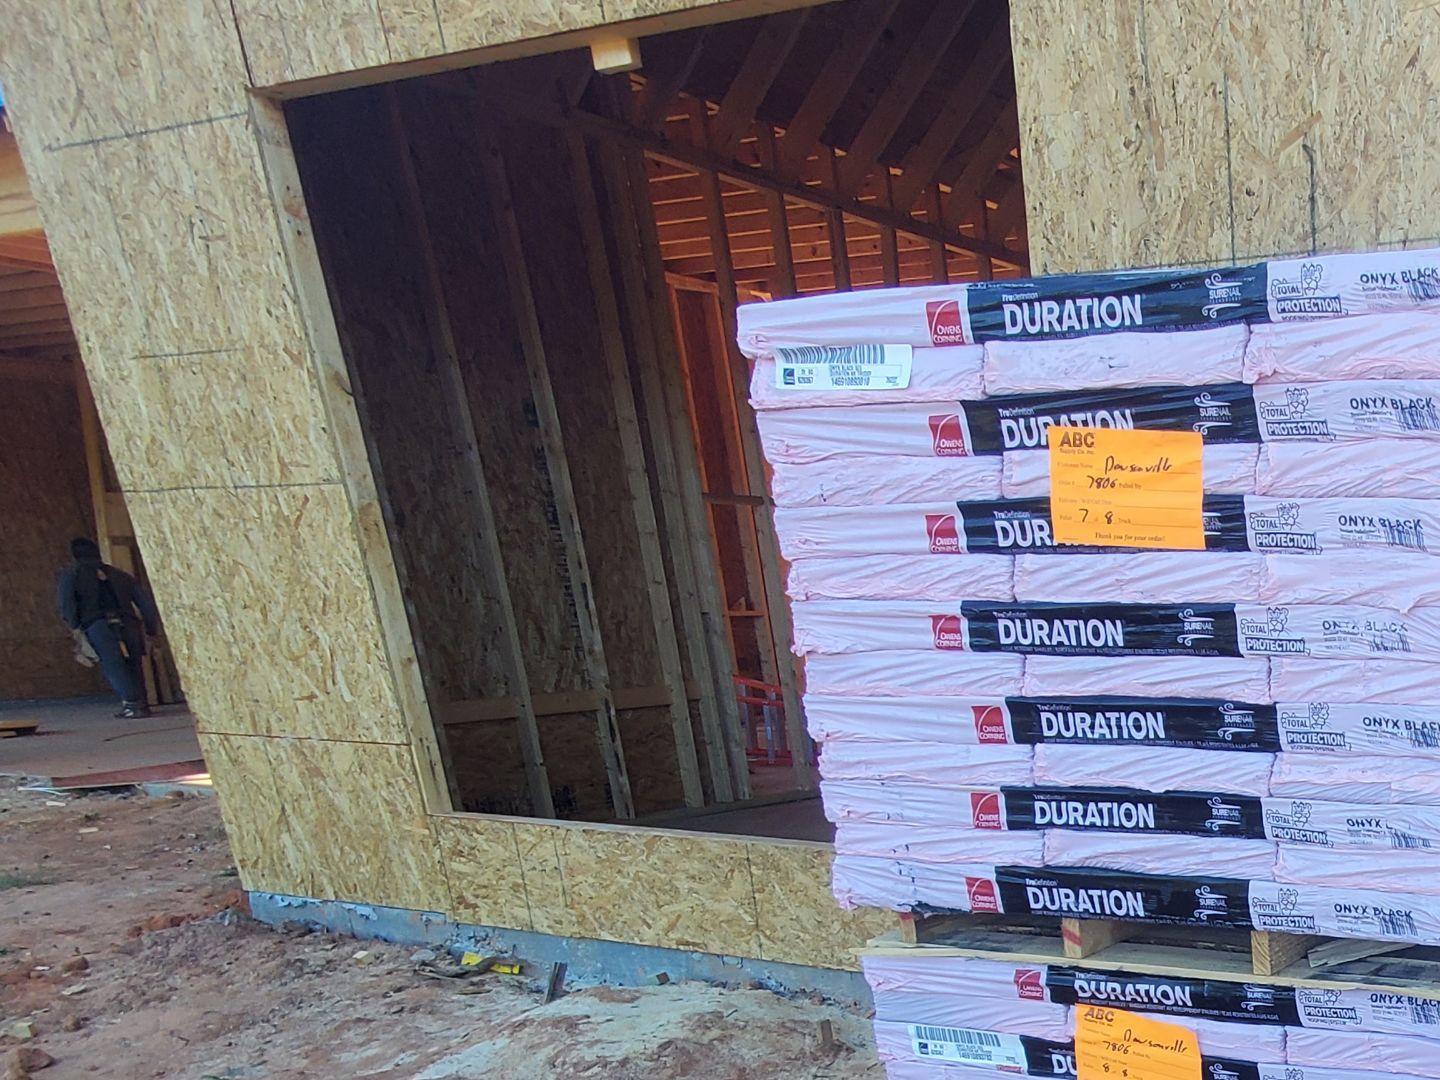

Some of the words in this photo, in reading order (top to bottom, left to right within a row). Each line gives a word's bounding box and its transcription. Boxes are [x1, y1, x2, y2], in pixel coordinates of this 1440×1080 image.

[1360, 273, 1398, 285] ONYX
[1401, 268, 1438, 283] BLACK
[1278, 286, 1301, 295] TOTAL
[1277, 299, 1340, 313] PROTECTION
[1003, 294, 1142, 335] DURATION
[1350, 398, 1388, 410] ONYX
[1391, 397, 1435, 411] BLACK
[1265, 406, 1288, 418] TOTAL
[1266, 421, 1328, 435] PROTECTION
[1059, 432, 1095, 448] ABC
[1087, 476, 1118, 489] 7806
[1078, 508, 1089, 523] 7
[1104, 511, 1113, 525] 8
[1338, 515, 1375, 528] ONYX
[1379, 517, 1422, 530] BLACK
[1255, 517, 1277, 529] TOTAL
[1256, 533, 1315, 548] PROTECTION
[999, 617, 1123, 646] DURATION
[1245, 624, 1267, 635] TOTAL
[1246, 638, 1305, 652] PROTECTION
[1040, 711, 1165, 739] DURATION
[1286, 717, 1310, 728] TOTAL
[1362, 717, 1400, 729] ONYX
[1286, 732, 1345, 747] PROTECTION
[1034, 800, 1154, 829] DURATION
[1270, 813, 1291, 824] TOTAL
[1346, 818, 1382, 829] ONYX
[1272, 828, 1327, 843] PROTECTION
[1026, 886, 1145, 917] DURATION
[1257, 902, 1279, 913] TOTAL
[1334, 904, 1370, 915] ONYX
[1373, 906, 1413, 920] BLACK
[1258, 914, 1314, 929] PROTECTION
[1074, 980, 1192, 1007] DURATION
[1303, 995, 1324, 1004] TOTAL
[1370, 993, 1405, 1006] ONYX
[1084, 1007, 1114, 1022] ABC
[1304, 1006, 1356, 1020] PROTECTION
[1102, 1041, 1131, 1055] 7806
[1102, 1063, 1110, 1073] 8
[1122, 1069, 1128, 1077] 8
